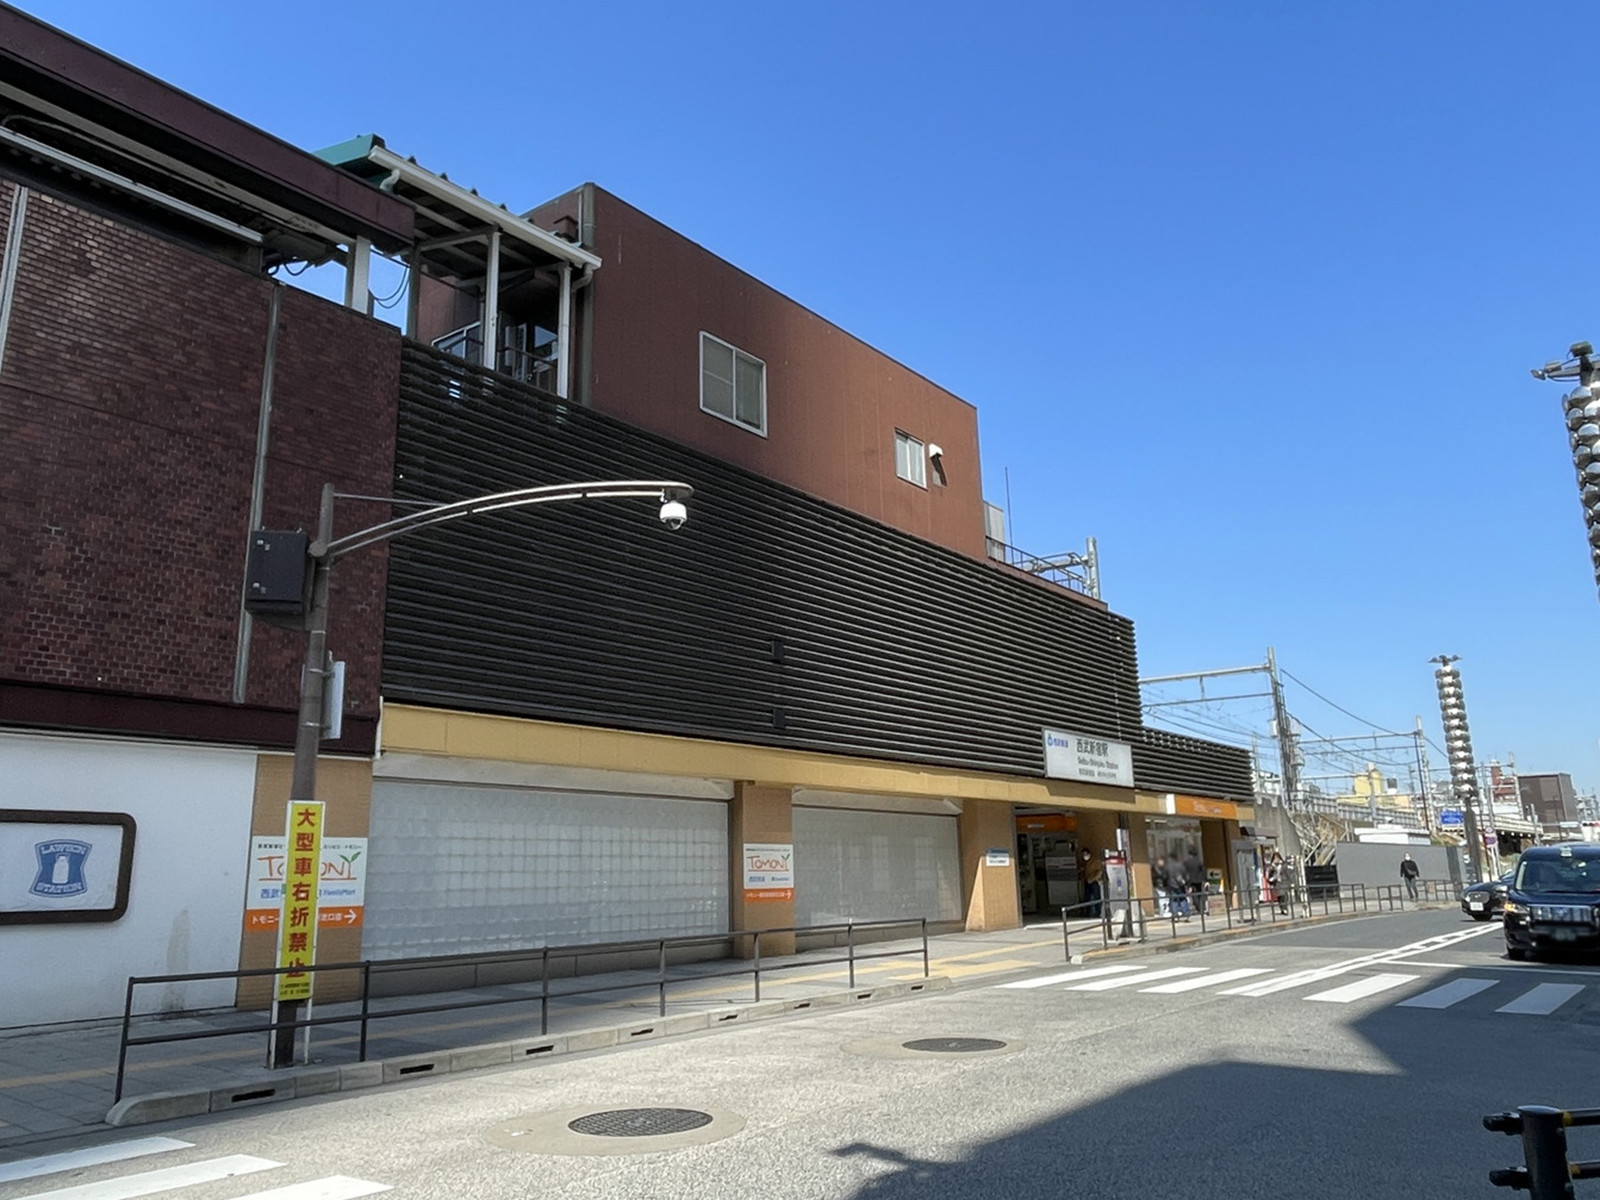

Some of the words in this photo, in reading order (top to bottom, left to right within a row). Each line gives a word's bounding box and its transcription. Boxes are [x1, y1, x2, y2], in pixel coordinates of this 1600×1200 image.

[1076, 738, 1109, 757] 西武新宿駅
[40, 843, 87, 855] LAWSON
[35, 882, 83, 893] STATION
[285, 808, 316, 979] 大型車右折禁止
